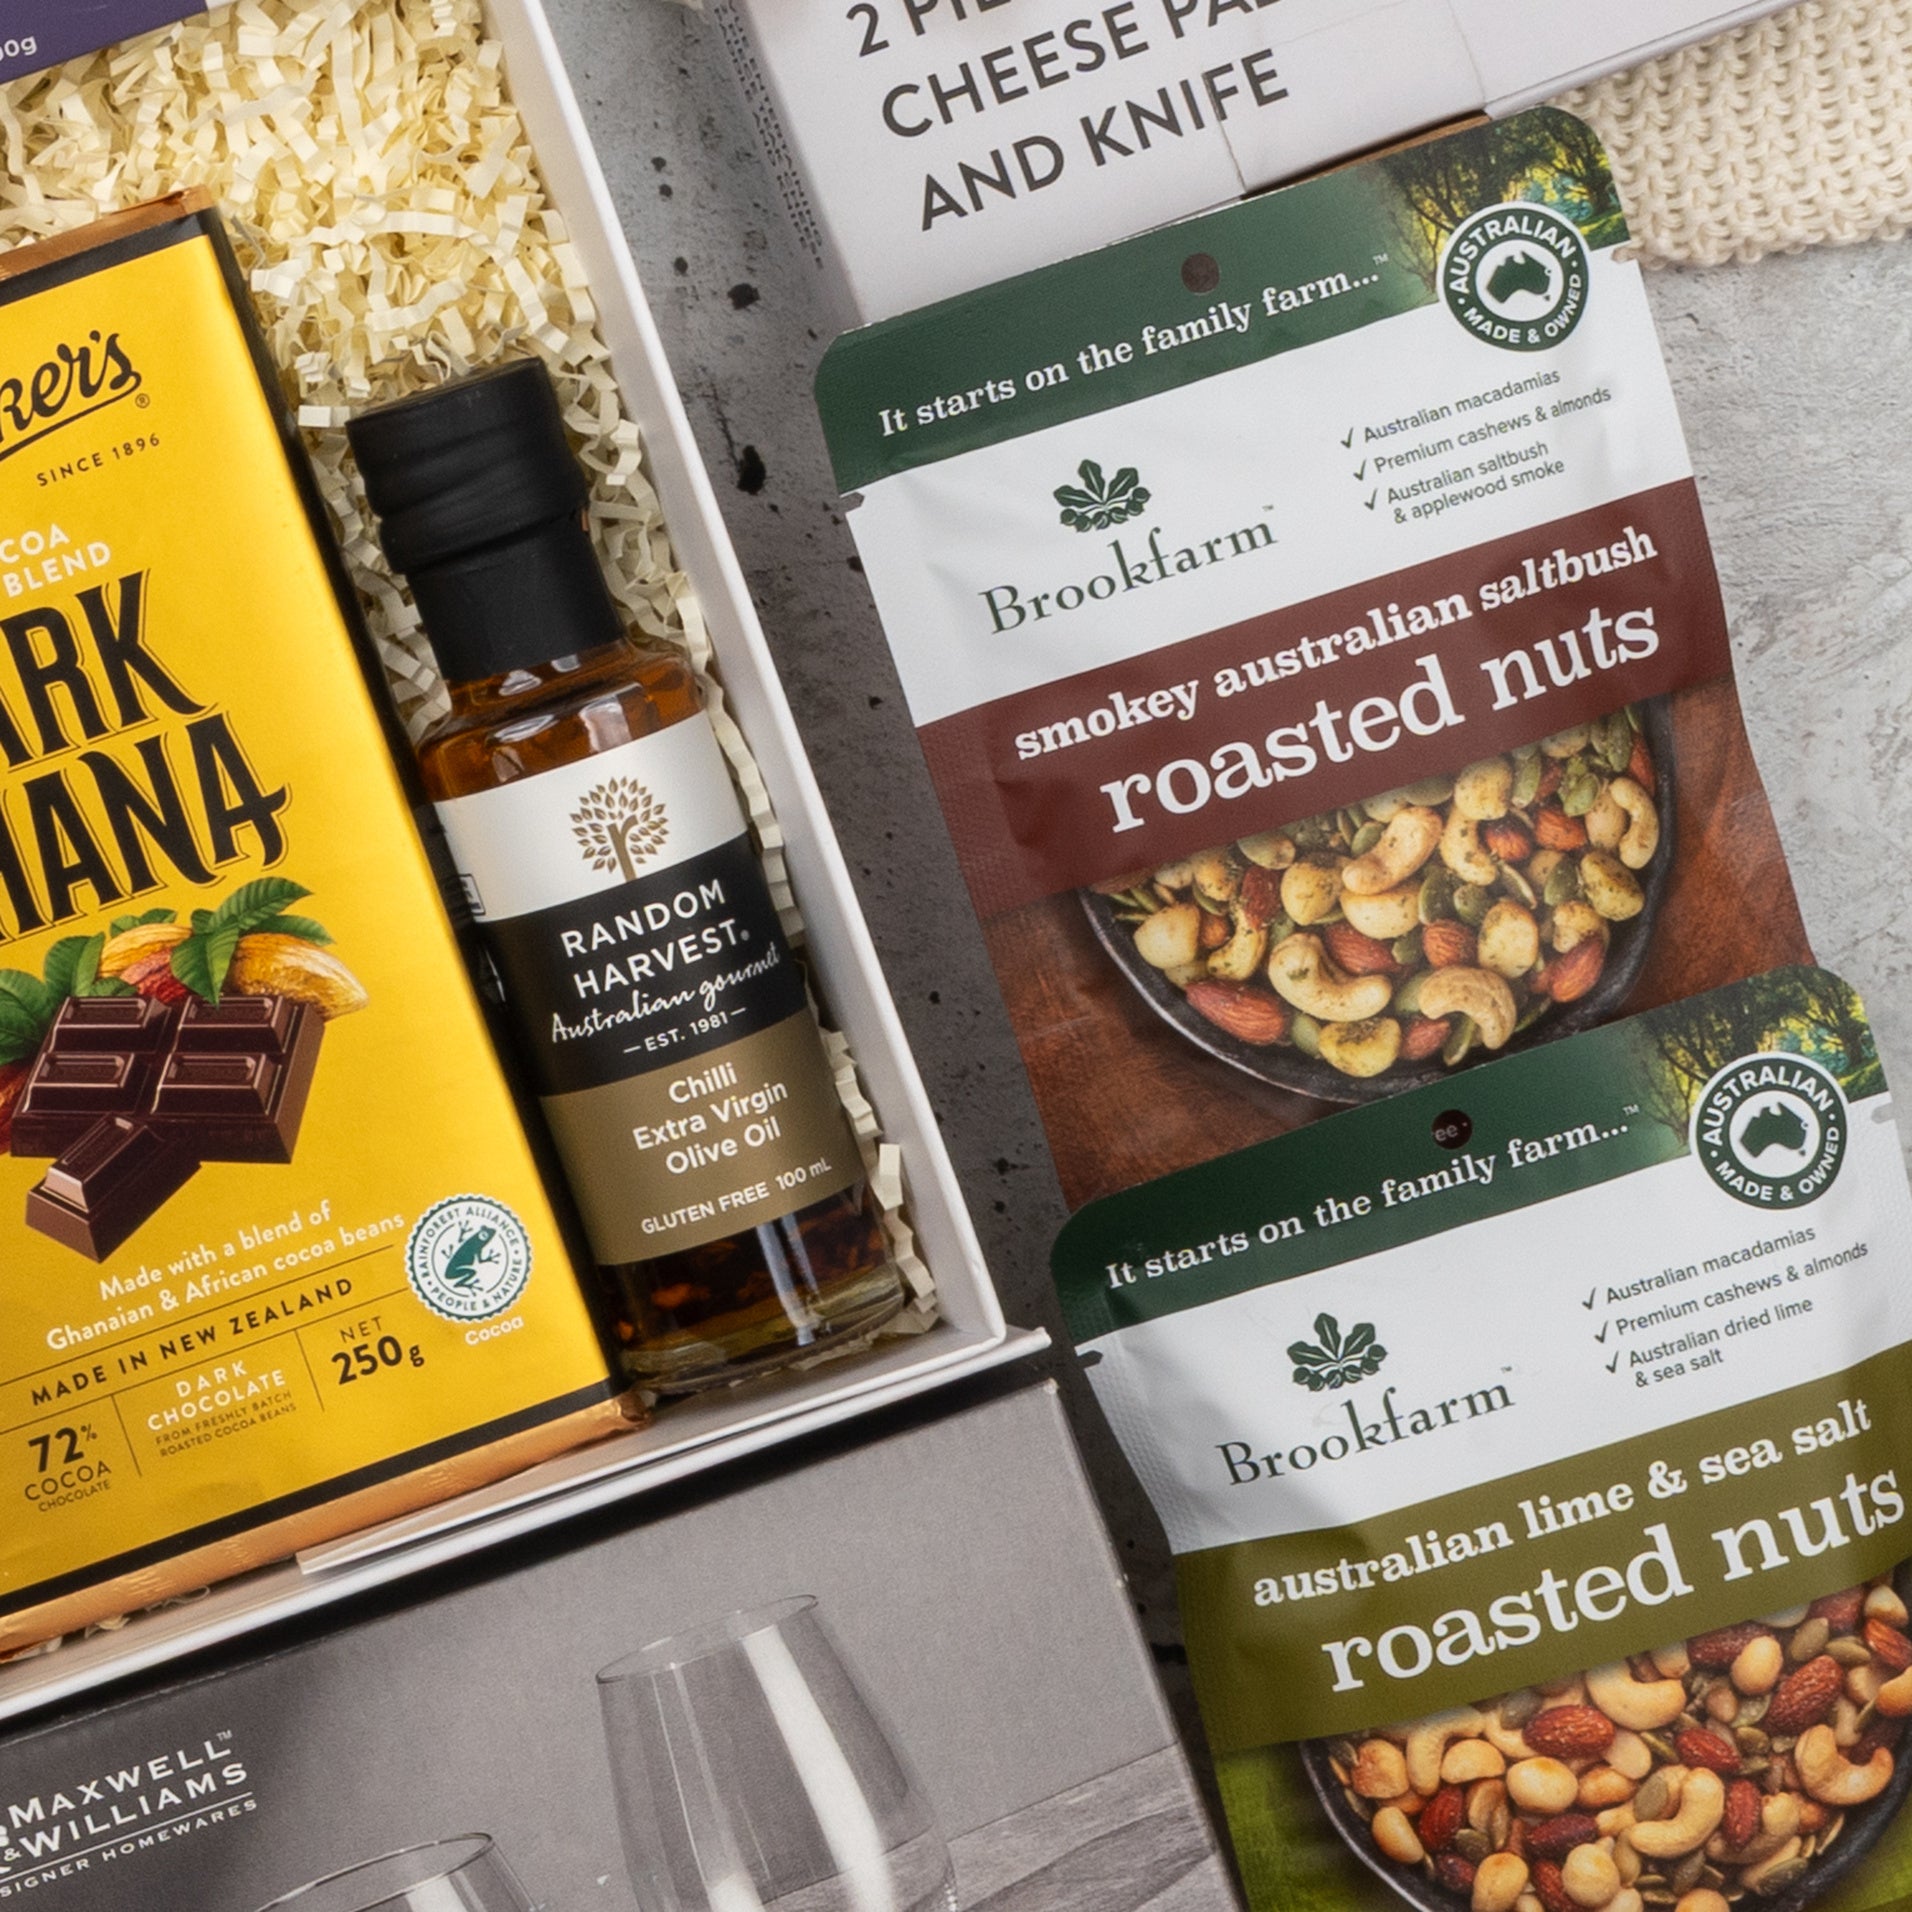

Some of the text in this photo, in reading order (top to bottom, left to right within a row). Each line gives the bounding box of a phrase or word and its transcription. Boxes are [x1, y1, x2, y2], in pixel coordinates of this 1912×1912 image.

[846, 3, 890, 58] 2
[882, 1, 1150, 138] CHEESE
[920, 48, 1289, 232] AND KNIFE
[1449, 215, 1577, 294] AUSTRALIAN
[1463, 274, 1581, 344] MADE & OWNED
[878, 408, 908, 437] It
[916, 377, 1017, 426] starts
[1024, 362, 1070, 392] on
[1076, 341, 1134, 375] the
[1141, 301, 1252, 356] family
[1363, 370, 1561, 443] Australian macadamias
[37, 433, 160, 487] SINCE 1896
[1373, 387, 1612, 473] Premium cashews & almonds
[1387, 441, 1550, 504] Australian saltbush
[1393, 460, 1565, 525] & applewood smoke
[3, 541, 111, 598] BLEND
[978, 526, 1278, 635] Brookfarm
[0, 568, 218, 774] RK
[1013, 524, 1658, 760] smokey australian saltbush
[1100, 606, 1661, 834] roasted nuts
[0, 711, 292, 946] ANA
[560, 878, 726, 958] RANDOM
[552, 941, 780, 1043] Australian gourmet
[690, 1012, 728, 1038] 1981
[632, 1081, 788, 1151] Extra Virgin
[668, 1061, 737, 1105] Chilli
[1702, 1065, 1834, 1146] AUSTRALIAN
[665, 1117, 781, 1176] Olive Oil
[1715, 1126, 1840, 1201] MADE & OWNED
[641, 1157, 832, 1235] GLUTEN FREE 100 mL
[1105, 1263, 1137, 1289] It
[1144, 1231, 1250, 1279] starts
[1258, 1216, 1305, 1245] on
[1313, 1195, 1372, 1228] the
[1380, 1153, 1496, 1208] family
[100, 1199, 331, 1301] Made with a blend of
[419, 1206, 520, 1278] RAINFOREST ALLIANCE
[1606, 1226, 1817, 1304] Australian macadamias
[46, 1214, 405, 1350] Ghanaian & African cocoa beans
[430, 1286, 477, 1311] PEOPLE
[493, 1258, 522, 1302] NATURE
[1615, 1241, 1869, 1336] Premium cashews & almonds
[31, 1278, 353, 1406] MADE IN NEW ZEALAND
[339, 1315, 382, 1343] NET
[465, 1316, 524, 1345] Cocoa
[1629, 1299, 1814, 1368] Australian dried lime
[147, 1369, 286, 1431] CHOCOLATE
[175, 1360, 247, 1398] DARK
[1634, 1348, 1724, 1388] & sea salt
[155, 1391, 292, 1445] FROM FRESHLY BATCH
[159, 1403, 297, 1458] ROASTED COCOA BEANS
[1215, 1386, 1516, 1486] Brookfarm
[24, 1460, 112, 1501] COCOA
[38, 1480, 111, 1512] CHOCOLATE
[1253, 1398, 1873, 1608] australian lime & sea salt
[1321, 1470, 1906, 1694] roasted nuts
[4, 1762, 247, 1862] & WILLIAMS
[8, 1740, 231, 1829] MAXWELL
[102, 1799, 257, 1862] HOMEWARES
